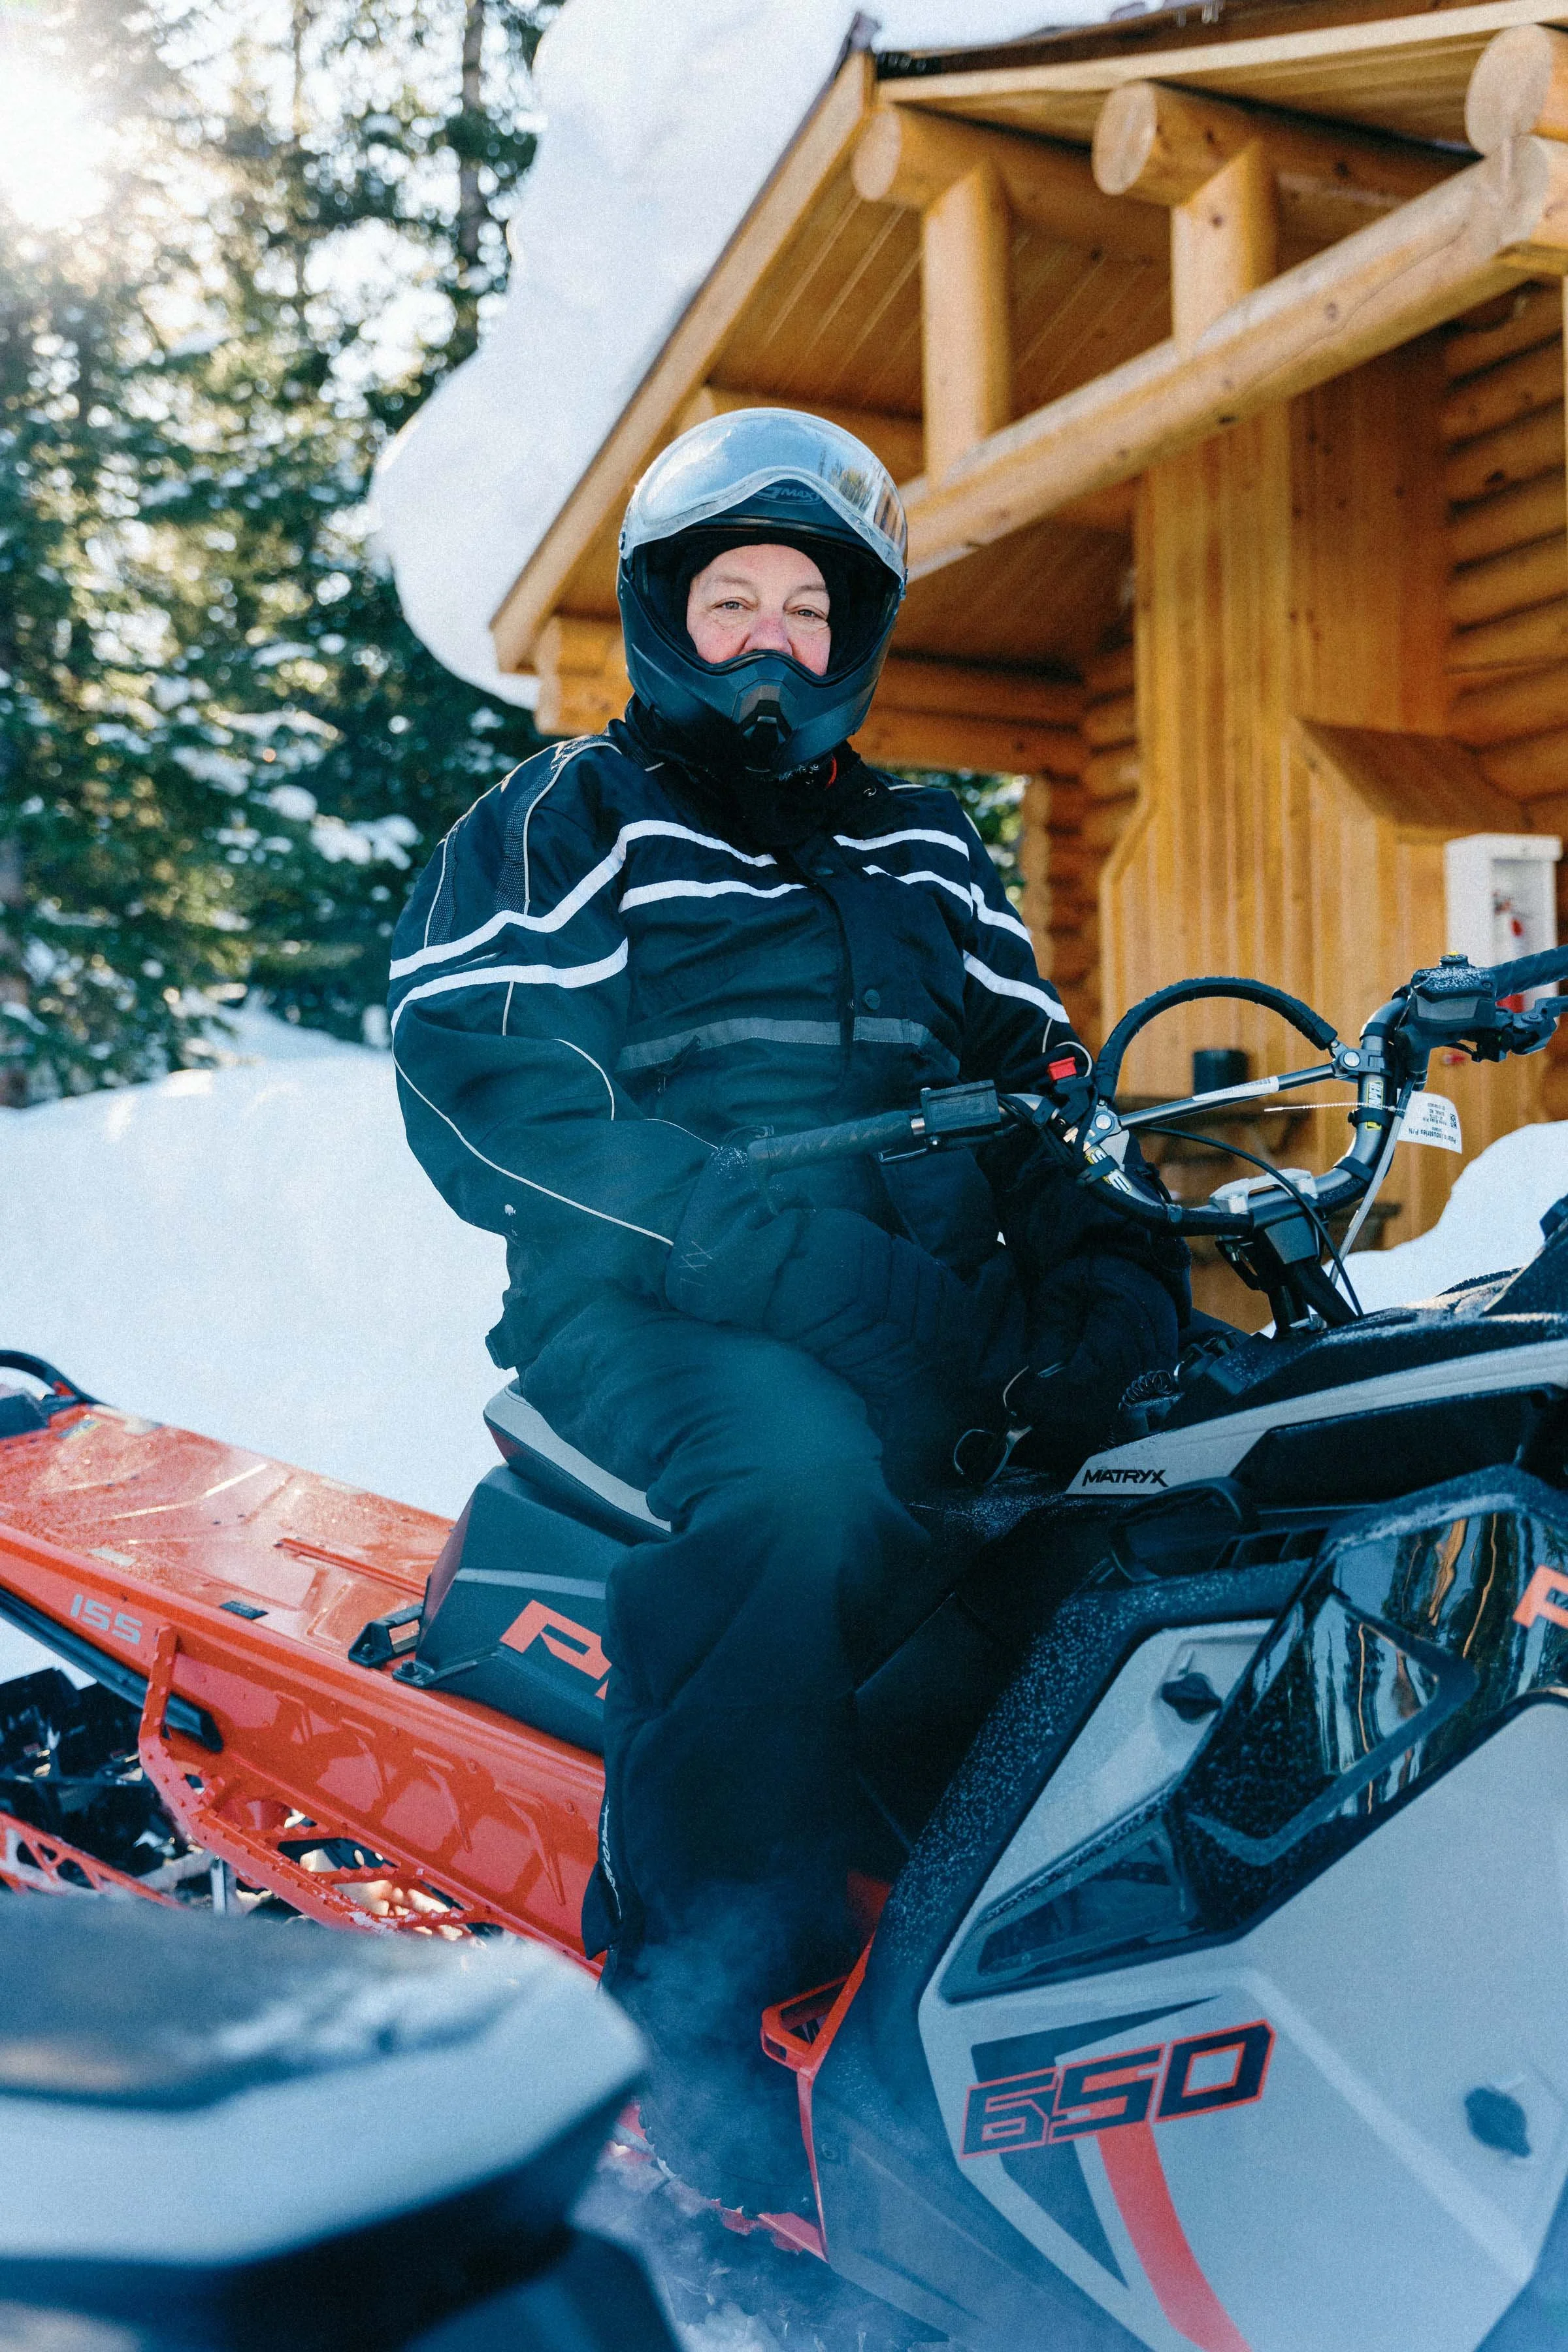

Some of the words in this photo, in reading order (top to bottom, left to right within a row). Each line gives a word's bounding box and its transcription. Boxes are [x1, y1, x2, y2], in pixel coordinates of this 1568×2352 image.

[1420, 1129, 1443, 1140] Industries
[1082, 1469, 1169, 1487] MATRYX
[71, 1594, 142, 1644] 155
[961, 2019, 1276, 2159] 650
